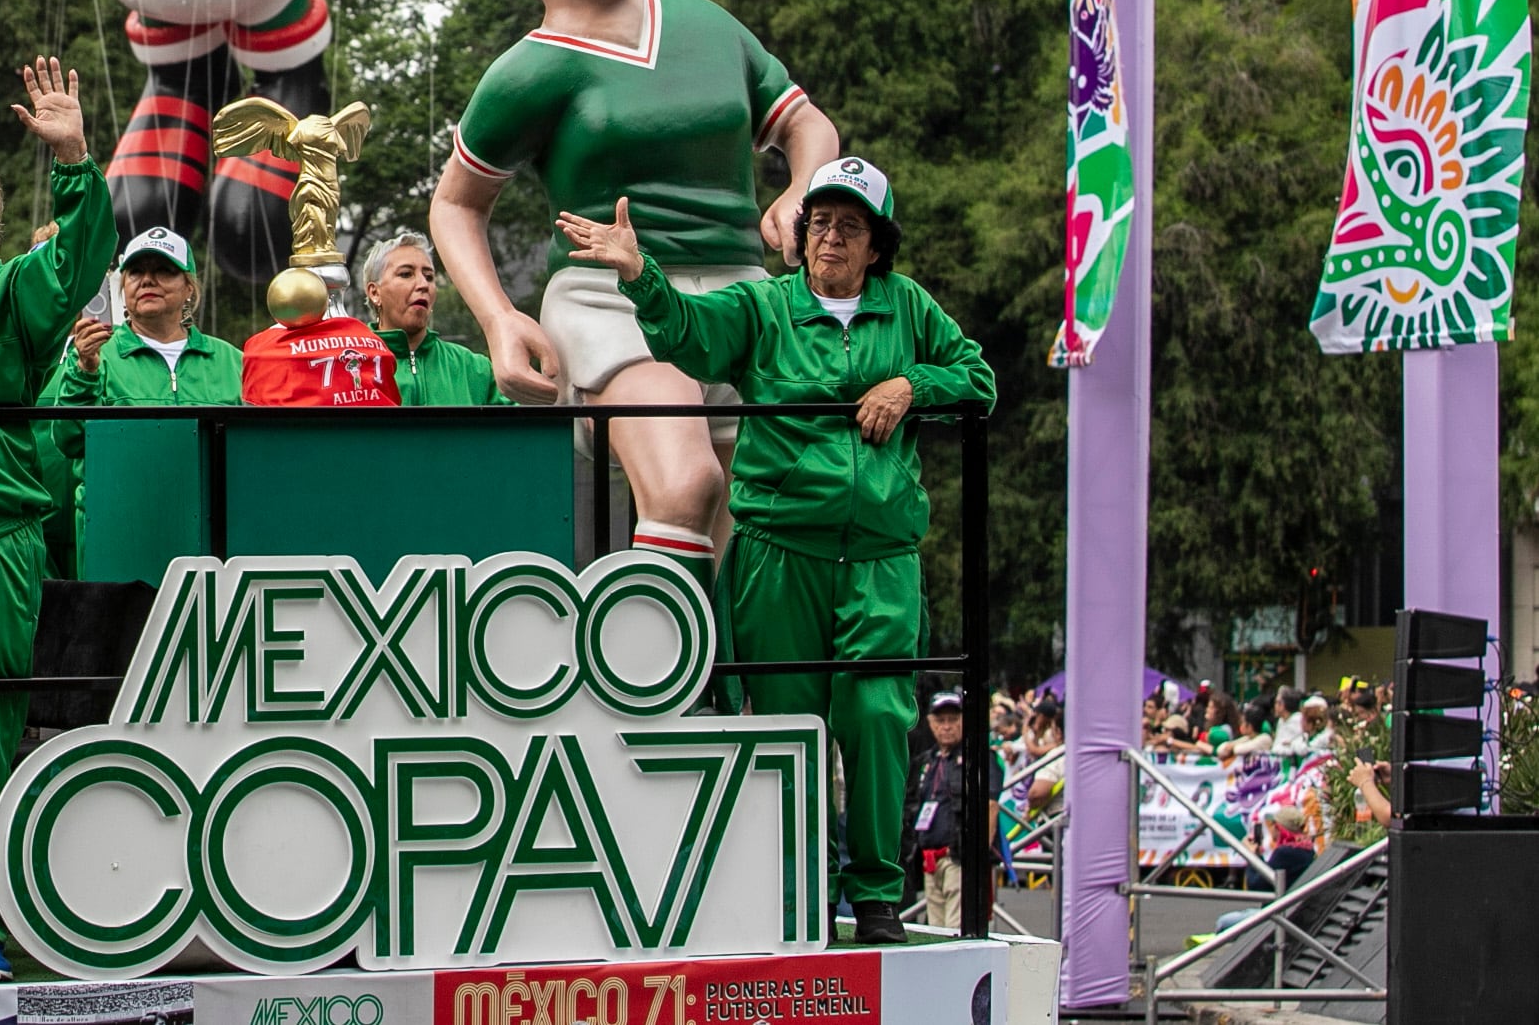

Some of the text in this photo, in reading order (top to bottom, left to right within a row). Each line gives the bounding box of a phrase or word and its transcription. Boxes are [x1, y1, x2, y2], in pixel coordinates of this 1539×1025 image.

[290, 336, 386, 355] MUNDIALISTA
[309, 355, 383, 389] 7 1
[333, 389, 380, 405] ALICIA
[127, 563, 709, 725] MEXICO
[706, 977, 849, 1001] PIONERAS DEL
[250, 993, 383, 1025] MEXICO
[706, 996, 870, 1022] FUTBOL FEMENIL
